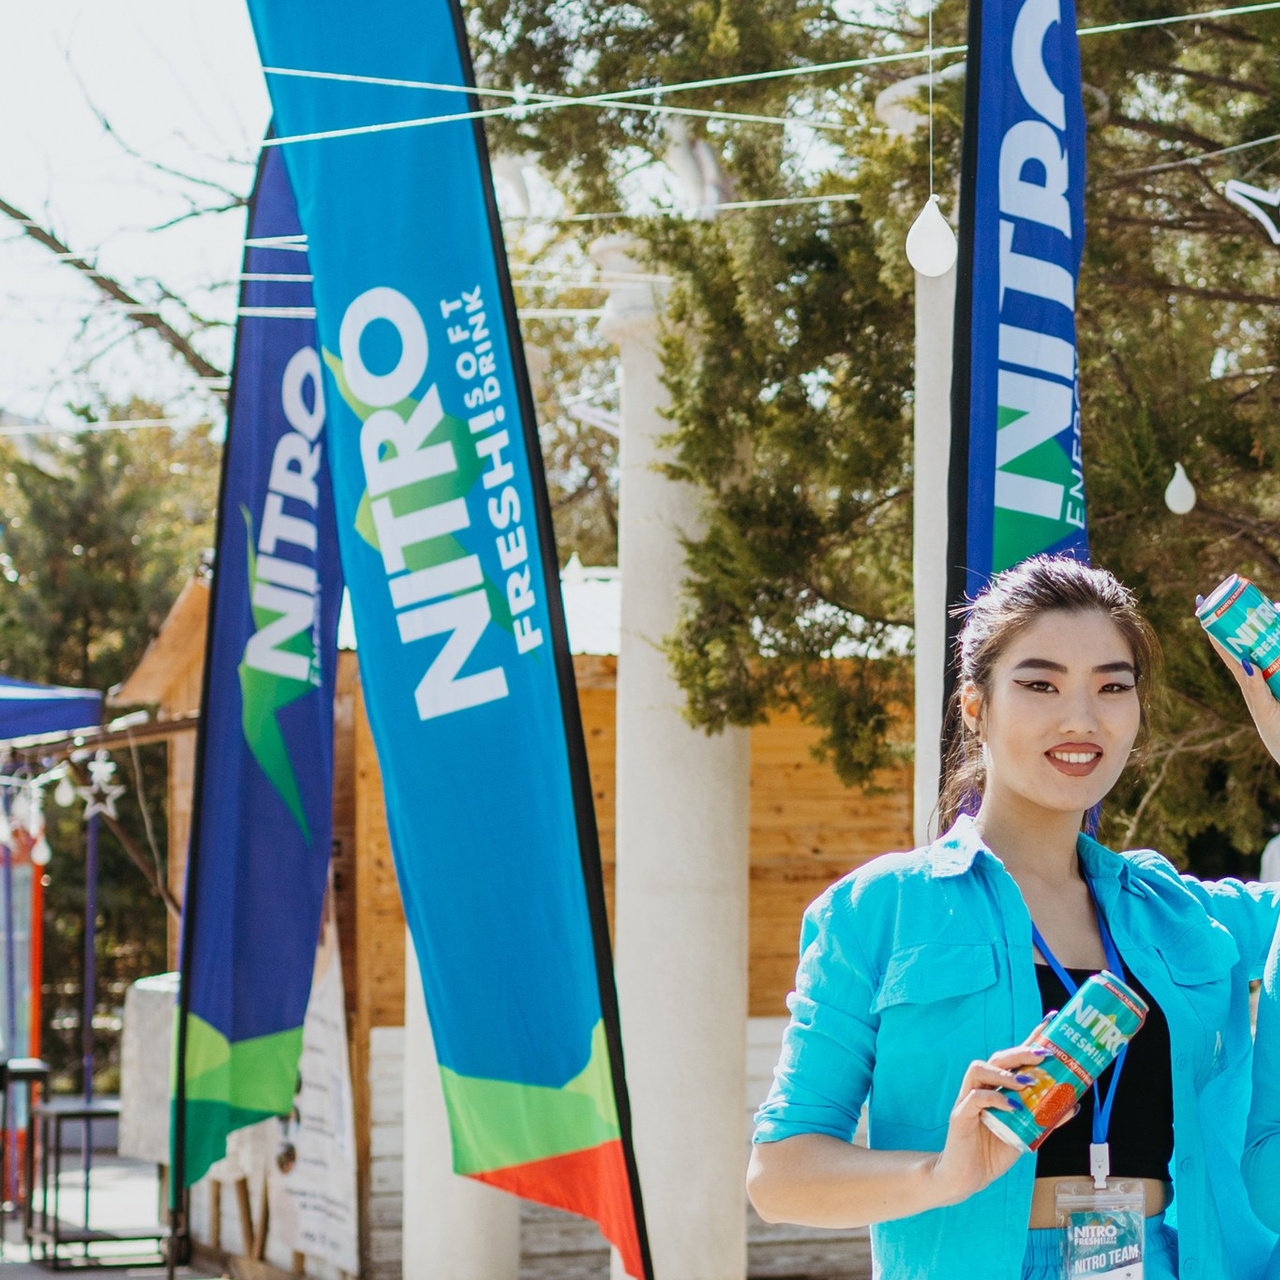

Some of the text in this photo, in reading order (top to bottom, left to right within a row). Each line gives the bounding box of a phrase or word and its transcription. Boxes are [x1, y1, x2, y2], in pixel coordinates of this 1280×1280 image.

[440, 298, 485, 409] SOFT
[460, 284, 500, 403] DRINK
[245, 345, 326, 683] NITRO
[339, 286, 509, 721] NITRO
[469, 406, 544, 655] FRESH!
[1058, 1023, 1100, 1062] FRESH!
[1074, 1225, 1117, 1238] NITRO
[1075, 1243, 1139, 1274] NITRO TEAM
